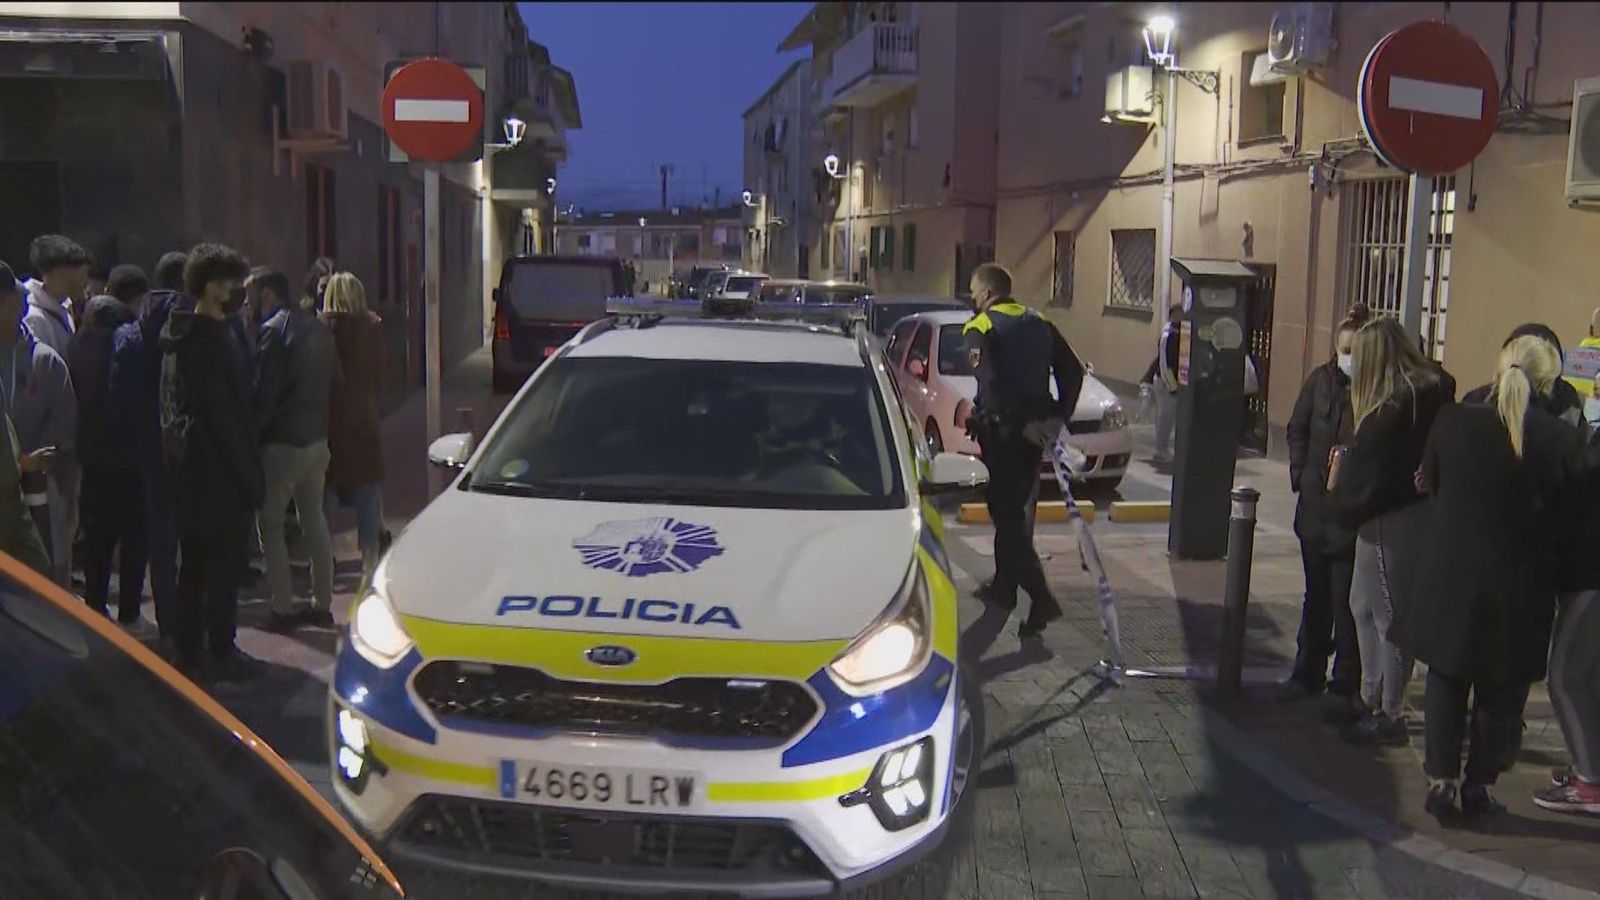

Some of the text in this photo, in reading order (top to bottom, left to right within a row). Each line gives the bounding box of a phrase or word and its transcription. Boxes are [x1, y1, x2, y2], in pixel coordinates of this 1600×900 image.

[496, 595, 742, 629] POLICIA
[523, 766, 695, 807] 4669 LRW
